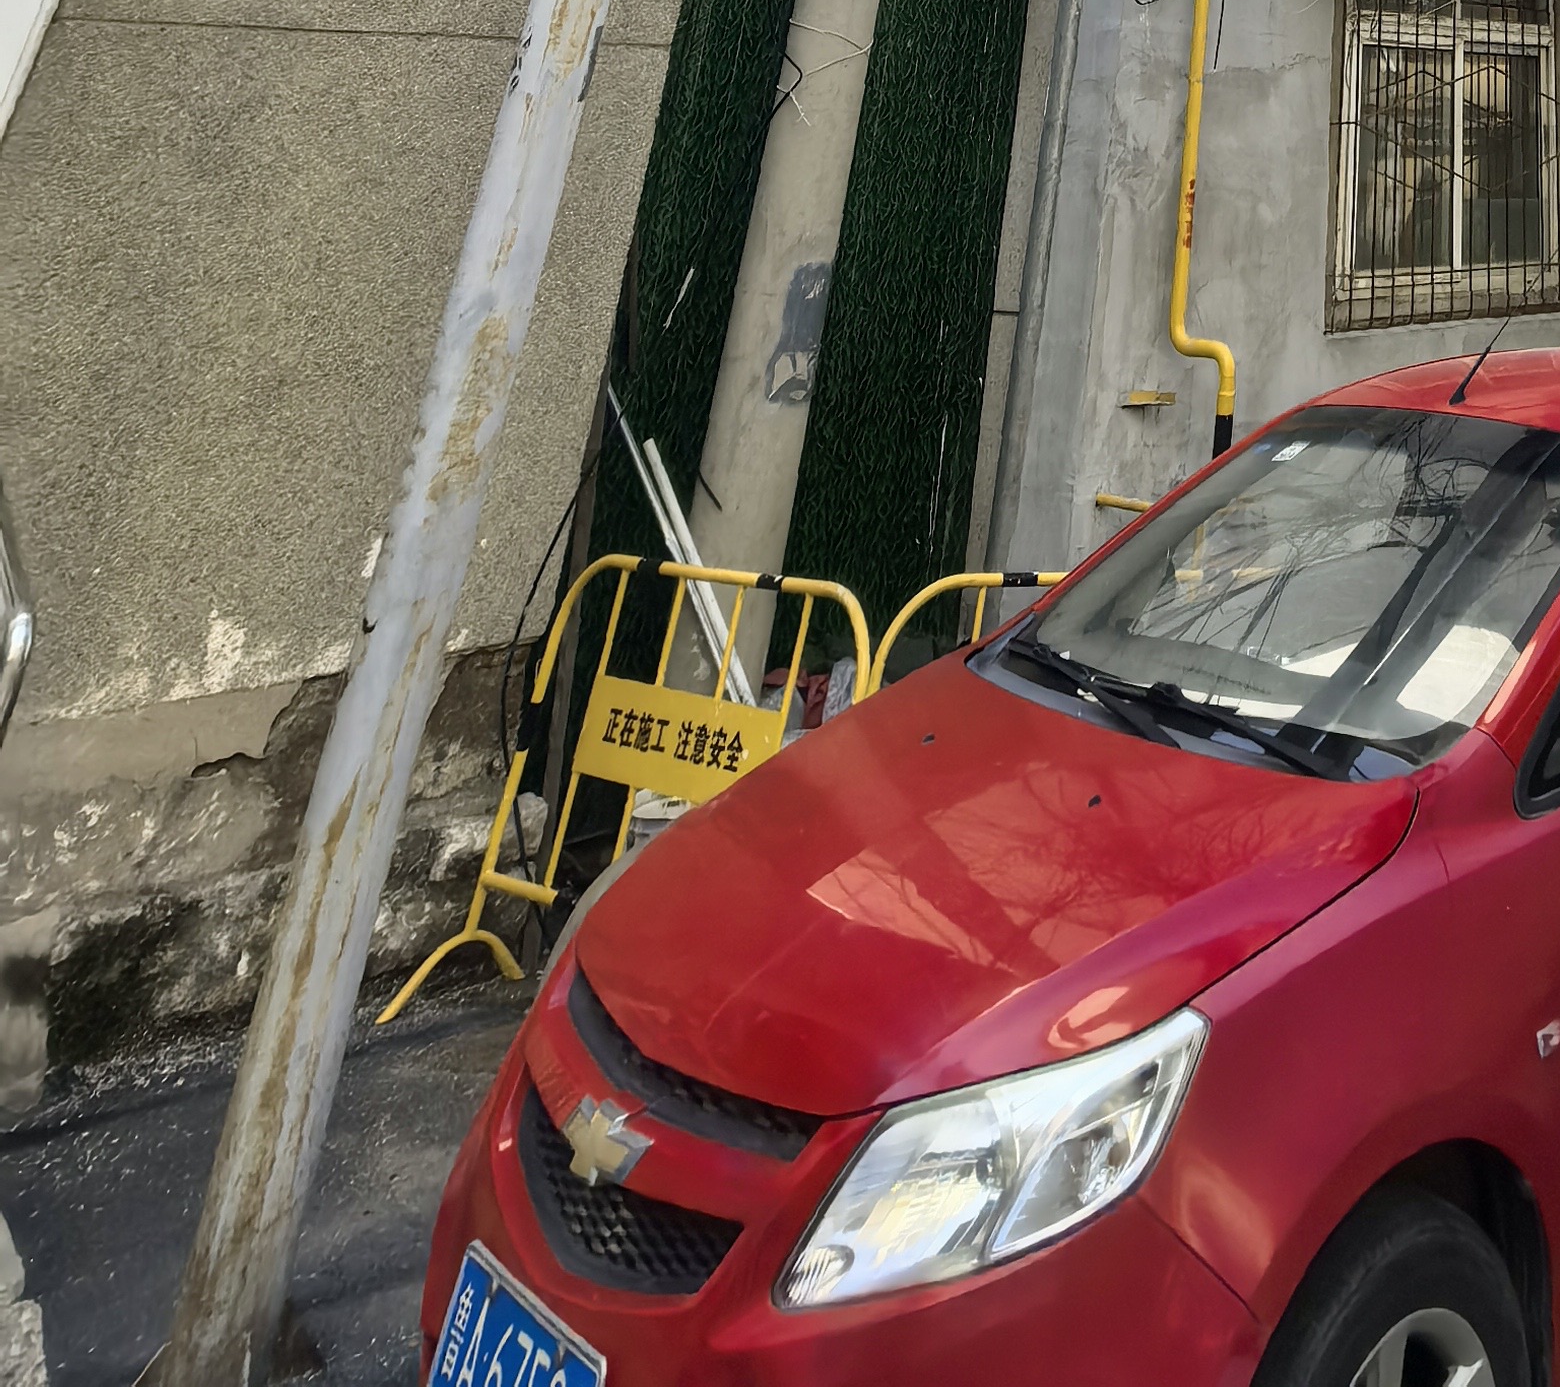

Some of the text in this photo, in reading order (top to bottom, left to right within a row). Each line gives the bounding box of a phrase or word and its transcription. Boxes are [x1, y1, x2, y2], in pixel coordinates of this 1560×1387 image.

[602, 708, 743, 773] 正在施工 注意安全
